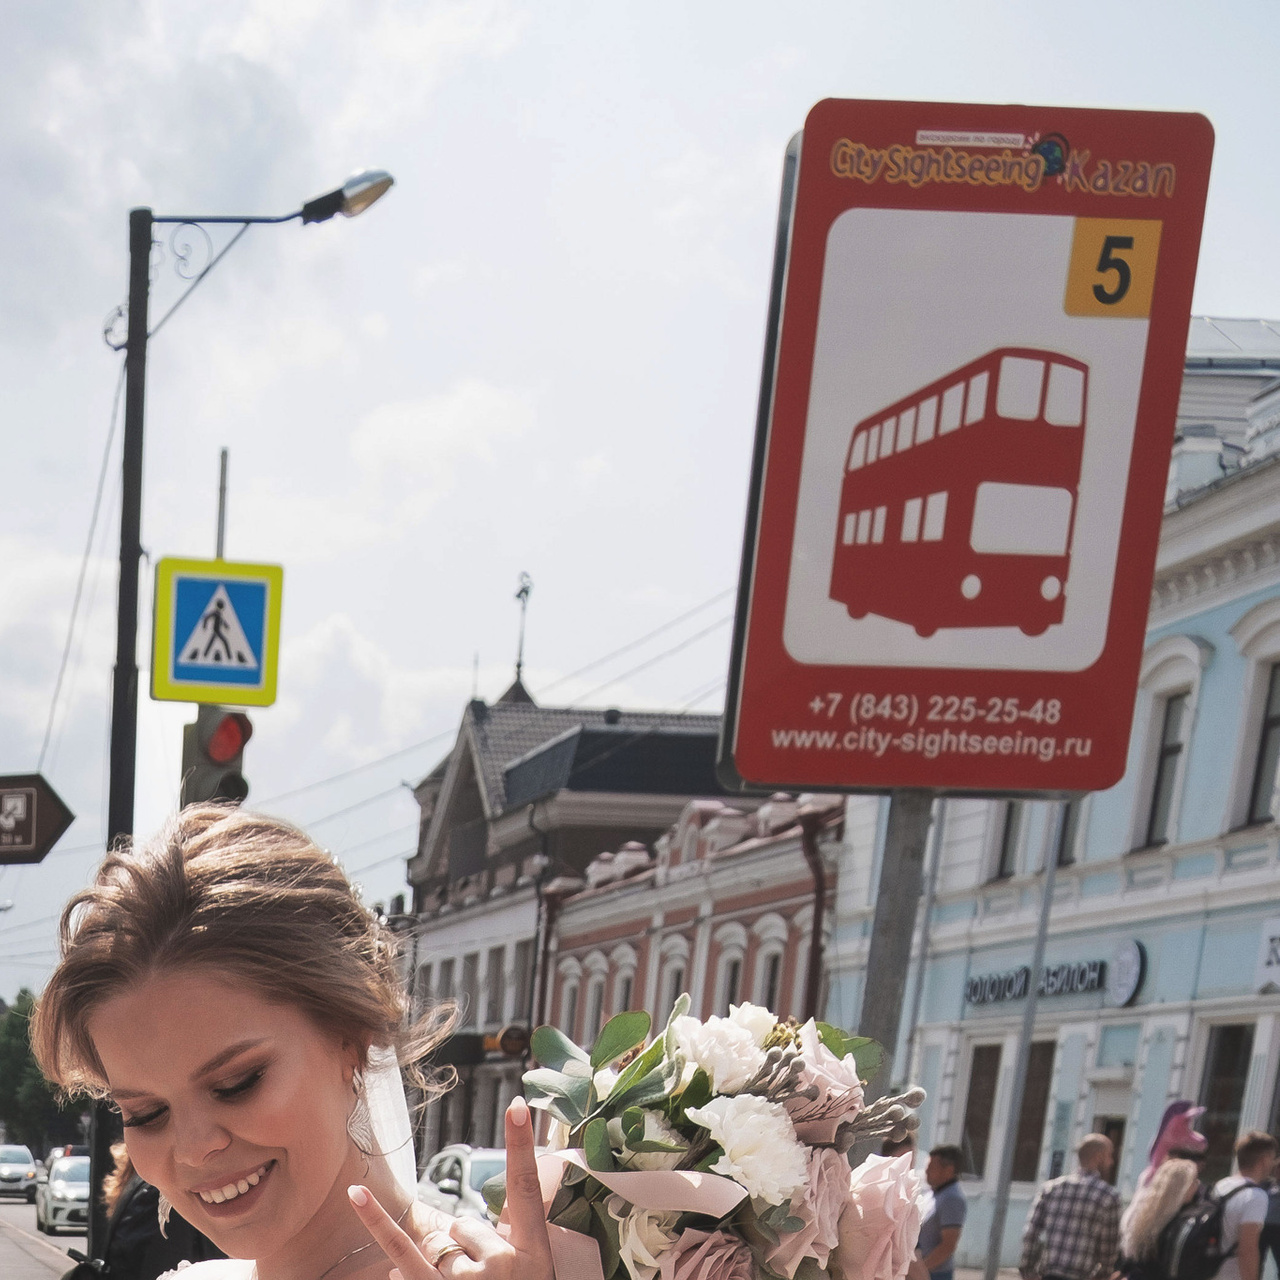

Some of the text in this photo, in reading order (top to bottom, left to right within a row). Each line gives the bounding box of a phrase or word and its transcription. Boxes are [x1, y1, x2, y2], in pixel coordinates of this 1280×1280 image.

[831, 138, 1176, 198] City Sightseeing Kazan
[1092, 235, 1135, 305] 5
[808, 692, 1062, 726] +7 (843) 225-25-48
[771, 726, 1092, 762] www.city-sightseeing.ru
